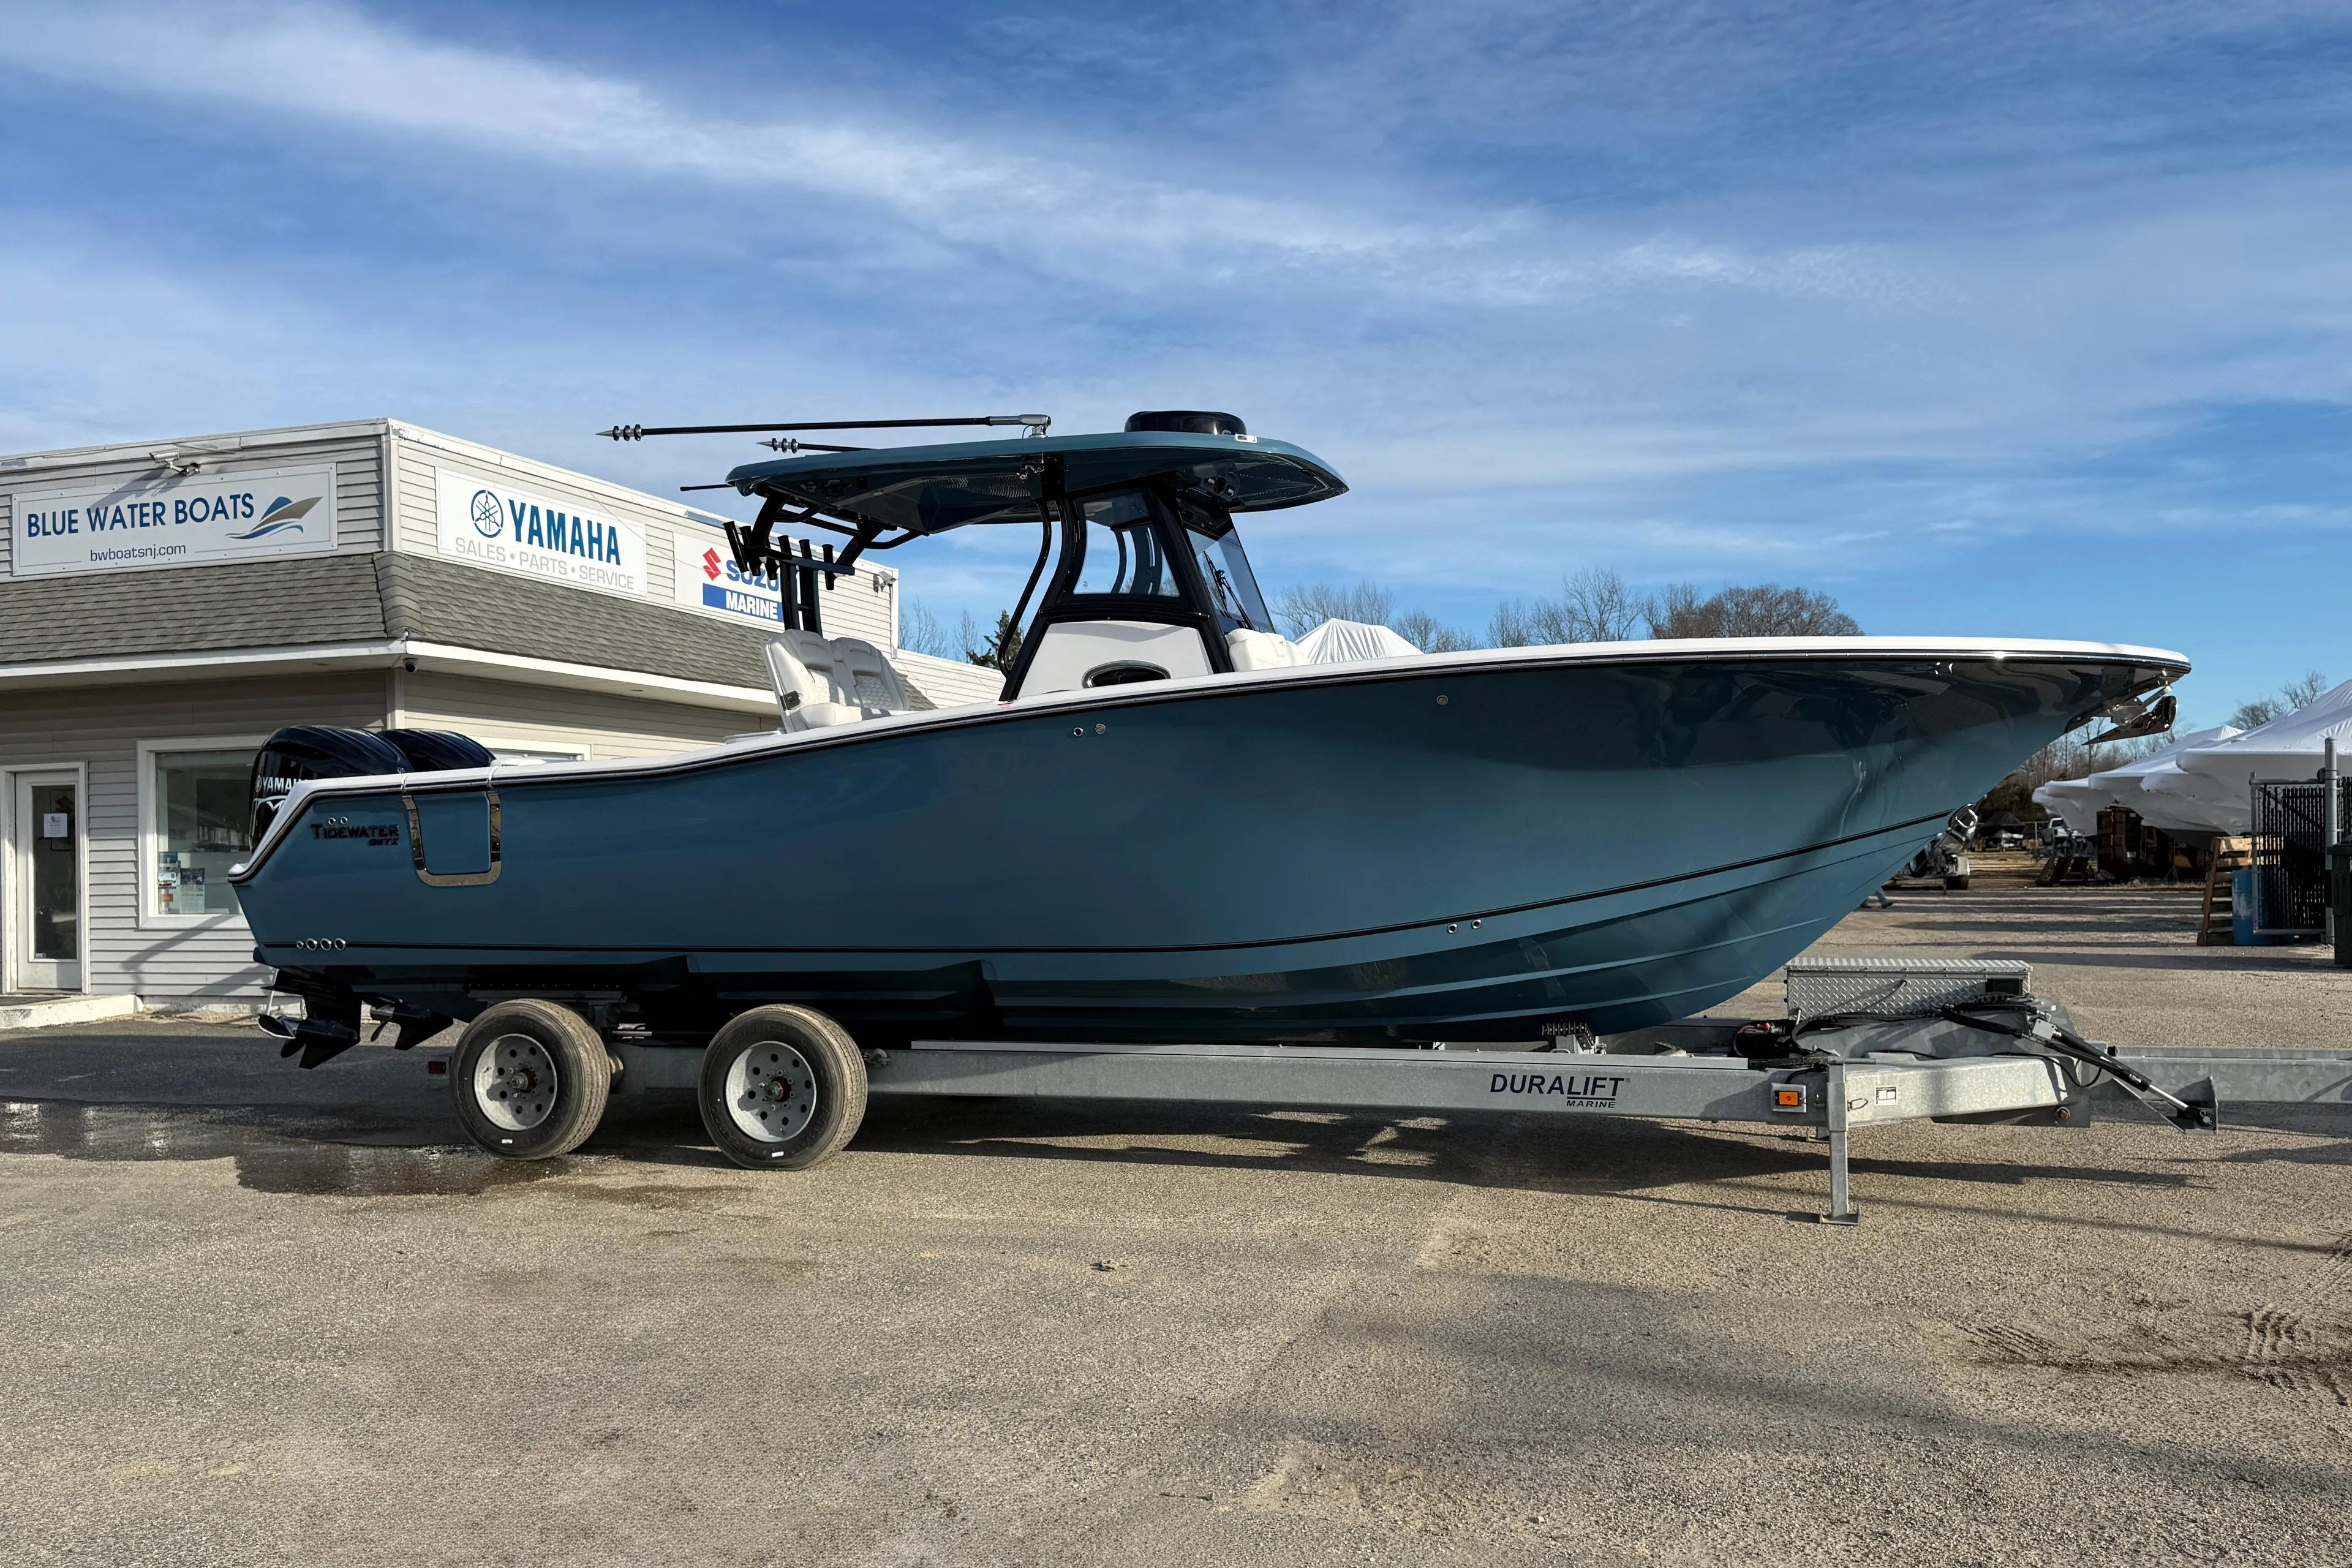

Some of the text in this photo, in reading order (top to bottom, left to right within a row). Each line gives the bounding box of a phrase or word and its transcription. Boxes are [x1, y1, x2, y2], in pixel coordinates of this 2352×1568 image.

[28, 492, 254, 538] BLUE WATER BOATS
[508, 499, 621, 566] YAMAHA
[90, 544, 186, 562] bwboatsnj.com
[455, 537, 635, 590] SALES PARTS SERVICE
[726, 559, 779, 592] SUZU
[725, 590, 778, 620] MARINE
[263, 776, 301, 793] YAMA
[311, 823, 400, 839] TIDEWATER
[1490, 1074, 1625, 1096] DURALIFT
[1566, 1099, 1616, 1108] MARINE
